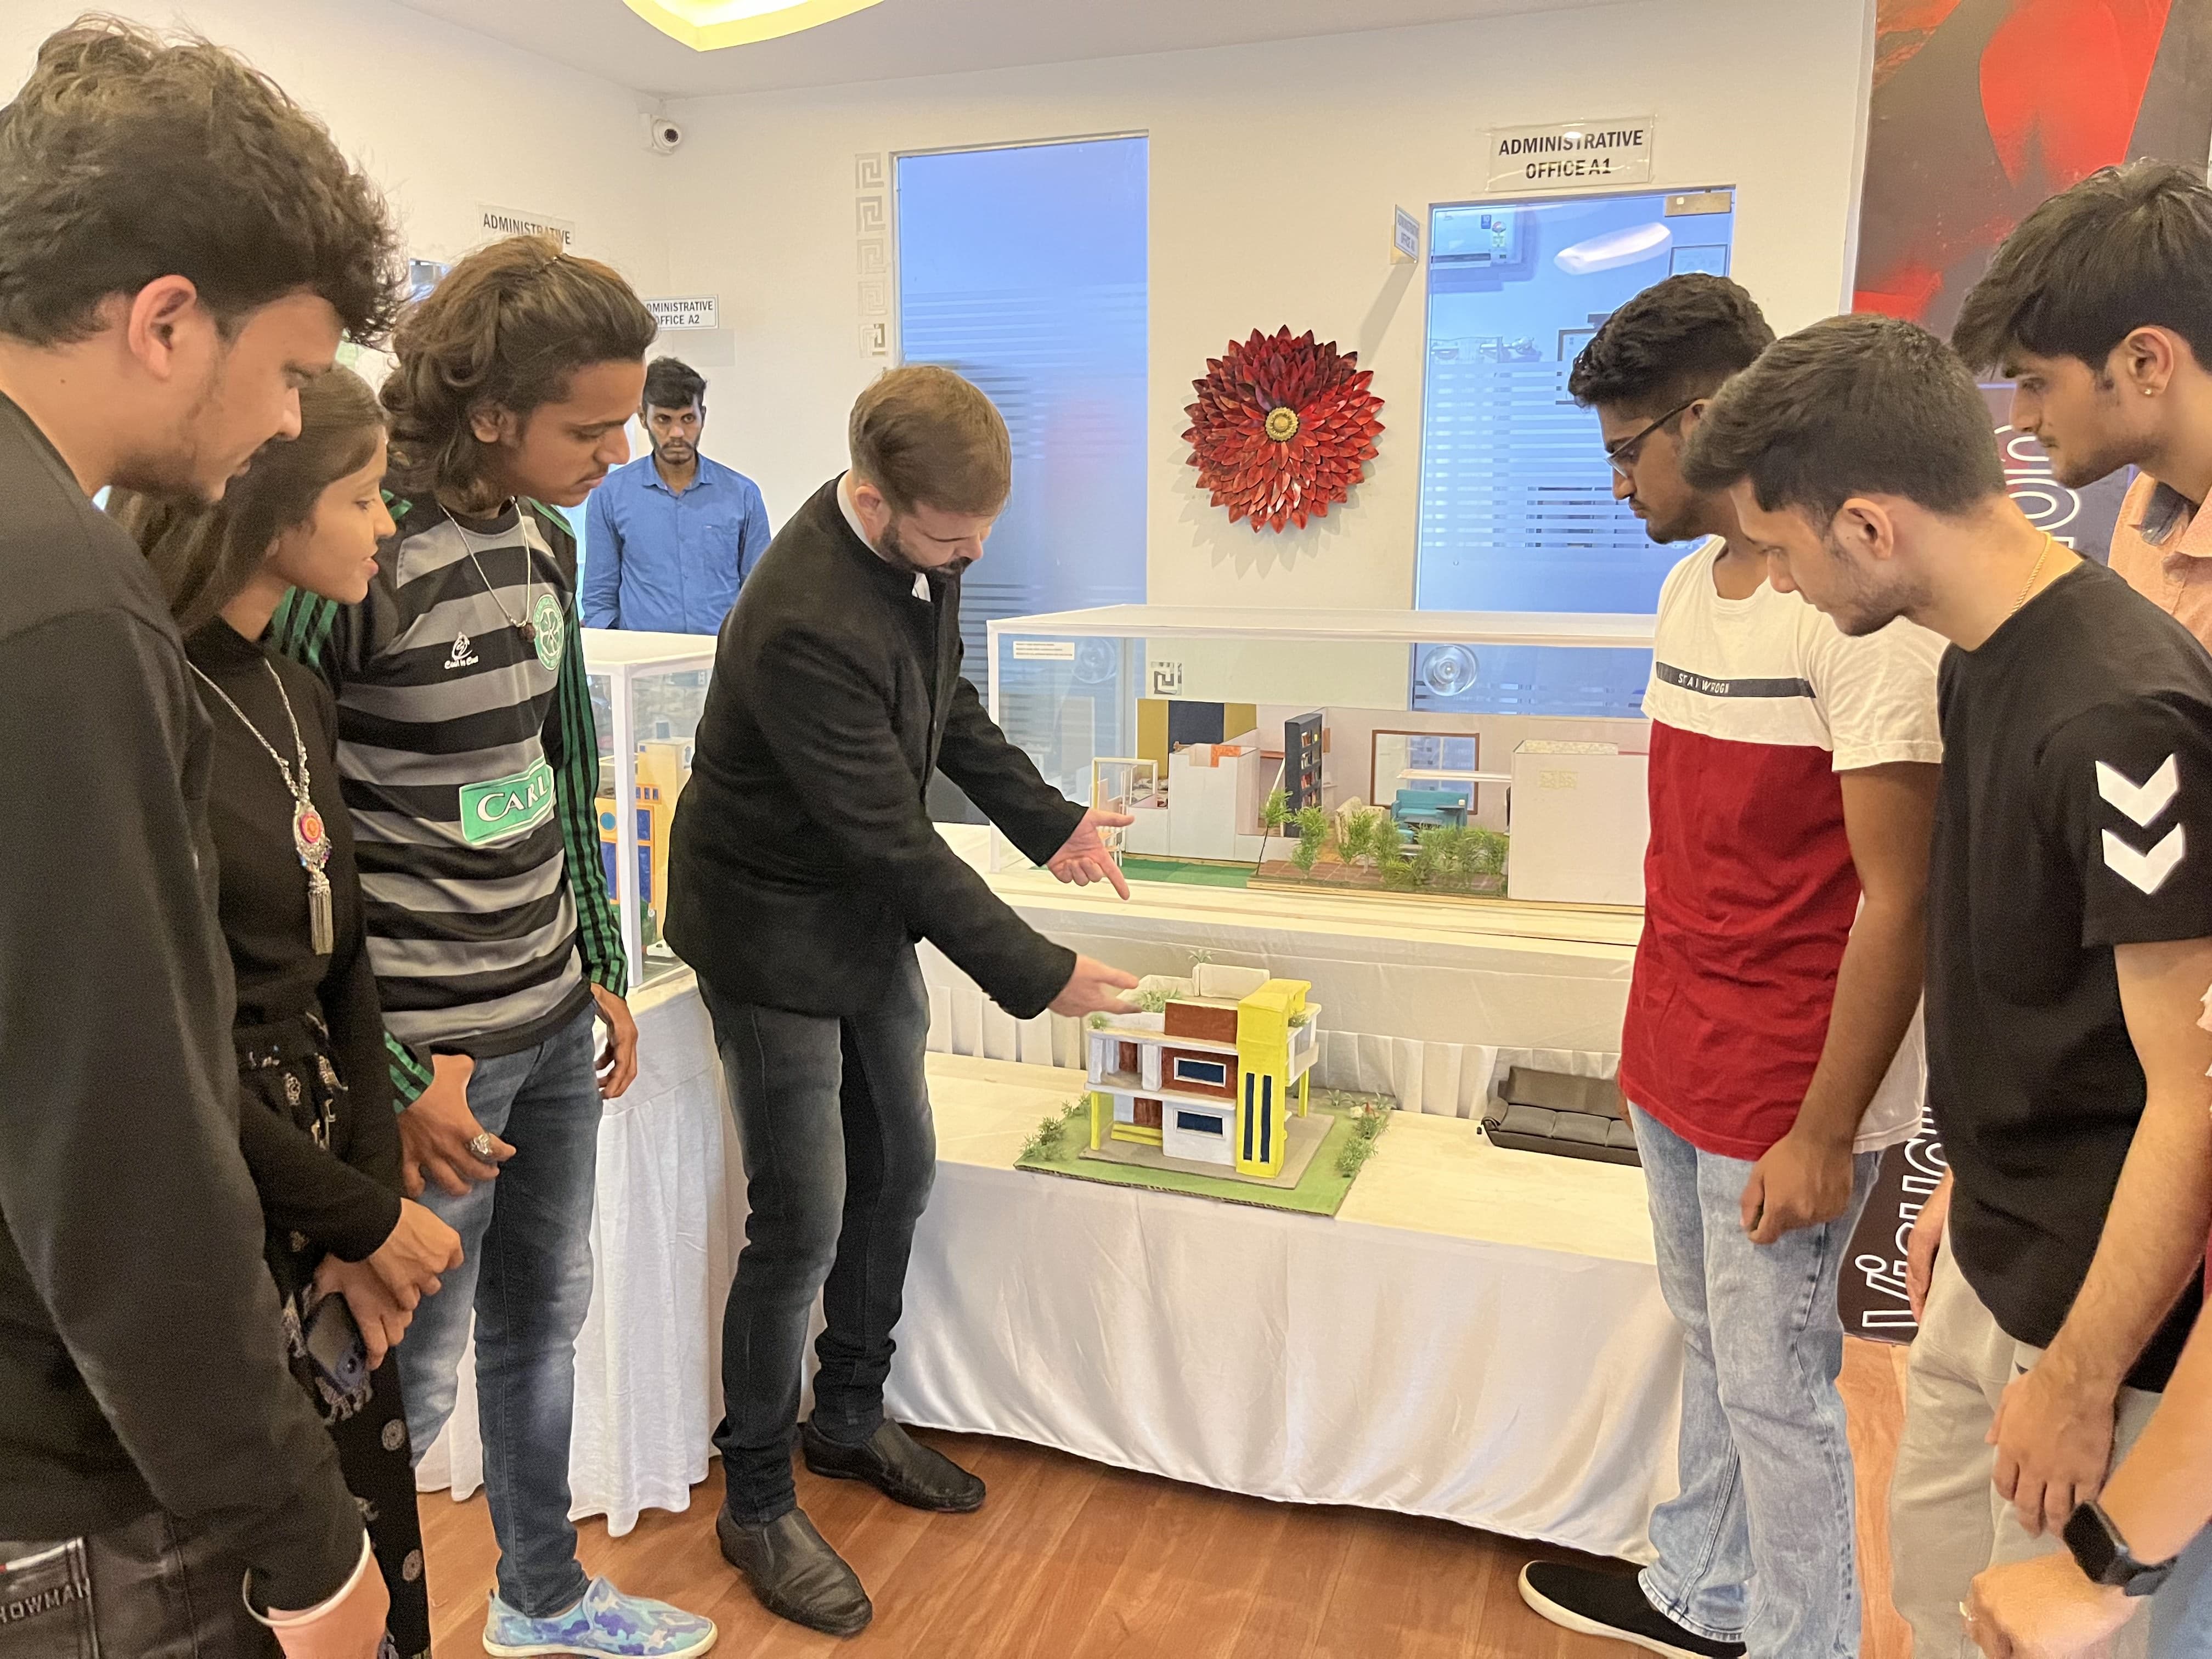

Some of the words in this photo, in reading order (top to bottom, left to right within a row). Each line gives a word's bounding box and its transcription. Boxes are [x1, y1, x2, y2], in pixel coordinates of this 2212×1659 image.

[1498, 129, 1643, 156] ADMINISTRATIVE
[1526, 160, 1585, 179] OFFICE
[1589, 158, 1611, 175] A1
[646, 301, 713, 312] DMINISTRATIVE
[689, 314, 699, 324] A2
